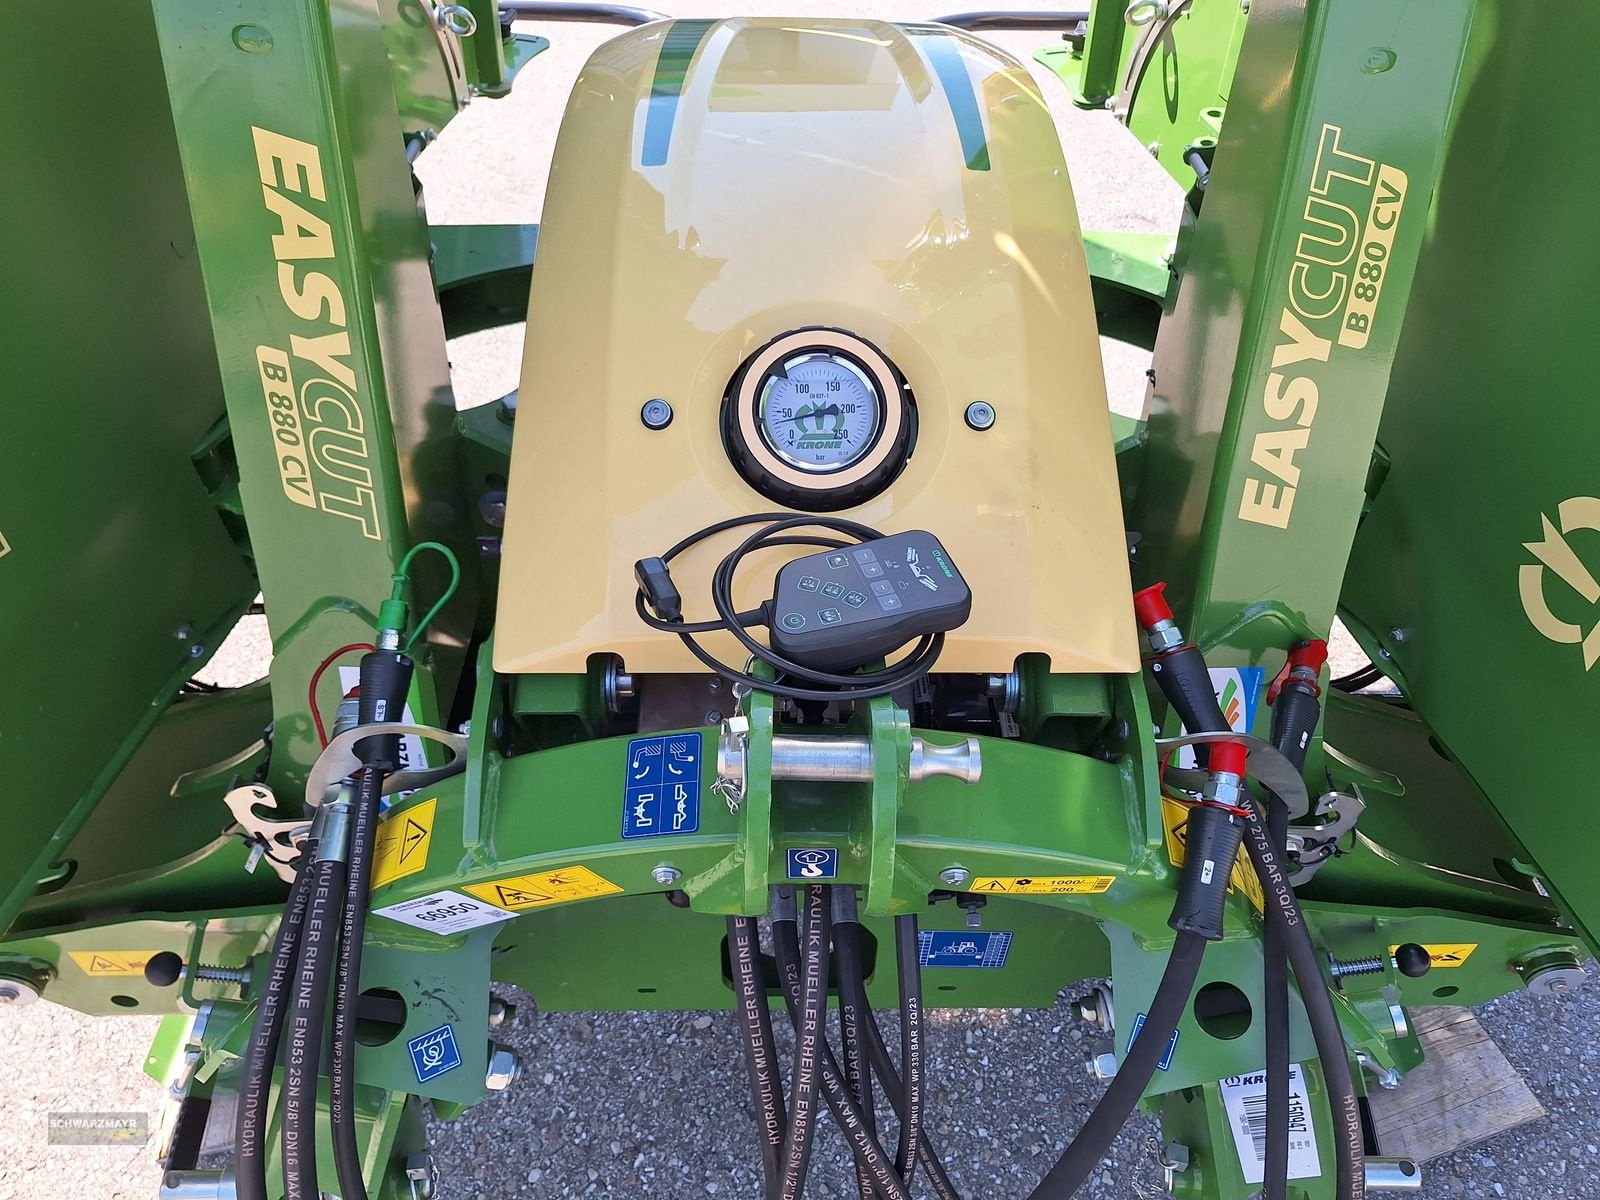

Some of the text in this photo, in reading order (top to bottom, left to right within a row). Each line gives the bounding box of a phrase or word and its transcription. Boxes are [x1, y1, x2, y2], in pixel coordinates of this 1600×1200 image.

[1345, 179, 1402, 334] B 880 CV
[251, 125, 382, 540] EASYCUT
[1238, 123, 1375, 529] EASYCUT
[795, 384, 809, 393] 100
[826, 382, 840, 391] 150
[782, 408, 792, 418] 50
[840, 403, 856, 414] 200
[262, 361, 310, 497] B 880 CV
[789, 429, 795, 440] 0
[833, 429, 848, 440] 250
[796, 441, 843, 450] KRONE
[936, 556, 954, 579] KRONE
[359, 768, 373, 800] AULIK
[354, 802, 368, 854] MUELLER
[348, 856, 361, 898] RHEINE
[1240, 799, 1299, 926] WP 275 BAR 3Q/23
[307, 862, 334, 943] MUELLER
[415, 902, 480, 922] 66950
[807, 884, 823, 945] RAULIK
[344, 904, 355, 937] EN853
[342, 938, 352, 960] 2SN
[297, 946, 318, 1009] RHEINE
[737, 935, 755, 996] RHEINE
[337, 984, 347, 1010] DN10
[805, 951, 820, 1031] MUELLER
[242, 1074, 262, 1157] HYDRAULIK
[254, 996, 279, 1070] MUELLER
[269, 932, 297, 992] RHEINE
[289, 878, 312, 925] EN853
[844, 1005, 858, 1046] 3Q/23
[908, 997, 918, 1026] 2Q/23
[291, 1016, 308, 1065] EN853
[334, 1041, 343, 1057] WP
[745, 998, 769, 1069] MUELLER
[910, 1029, 919, 1051] BAR
[333, 1058, 342, 1074] 330
[799, 1034, 815, 1093] RHEINE
[847, 1050, 860, 1080] BAR
[911, 1052, 919, 1067] 330
[911, 1068, 919, 1082] WP
[288, 1067, 302, 1097] 2SN
[333, 1076, 342, 1096] BAR
[822, 1071, 839, 1093] WP
[1242, 1070, 1296, 1086] KRE
[757, 1072, 781, 1145] HYDRAULIK
[793, 1100, 809, 1142] EN853
[910, 1105, 919, 1123] DN10
[854, 1130, 878, 1164] DN12
[1343, 1095, 1362, 1169] HYDRAULIK
[286, 1131, 299, 1166] DN16
[789, 1144, 803, 1169] 2SN
